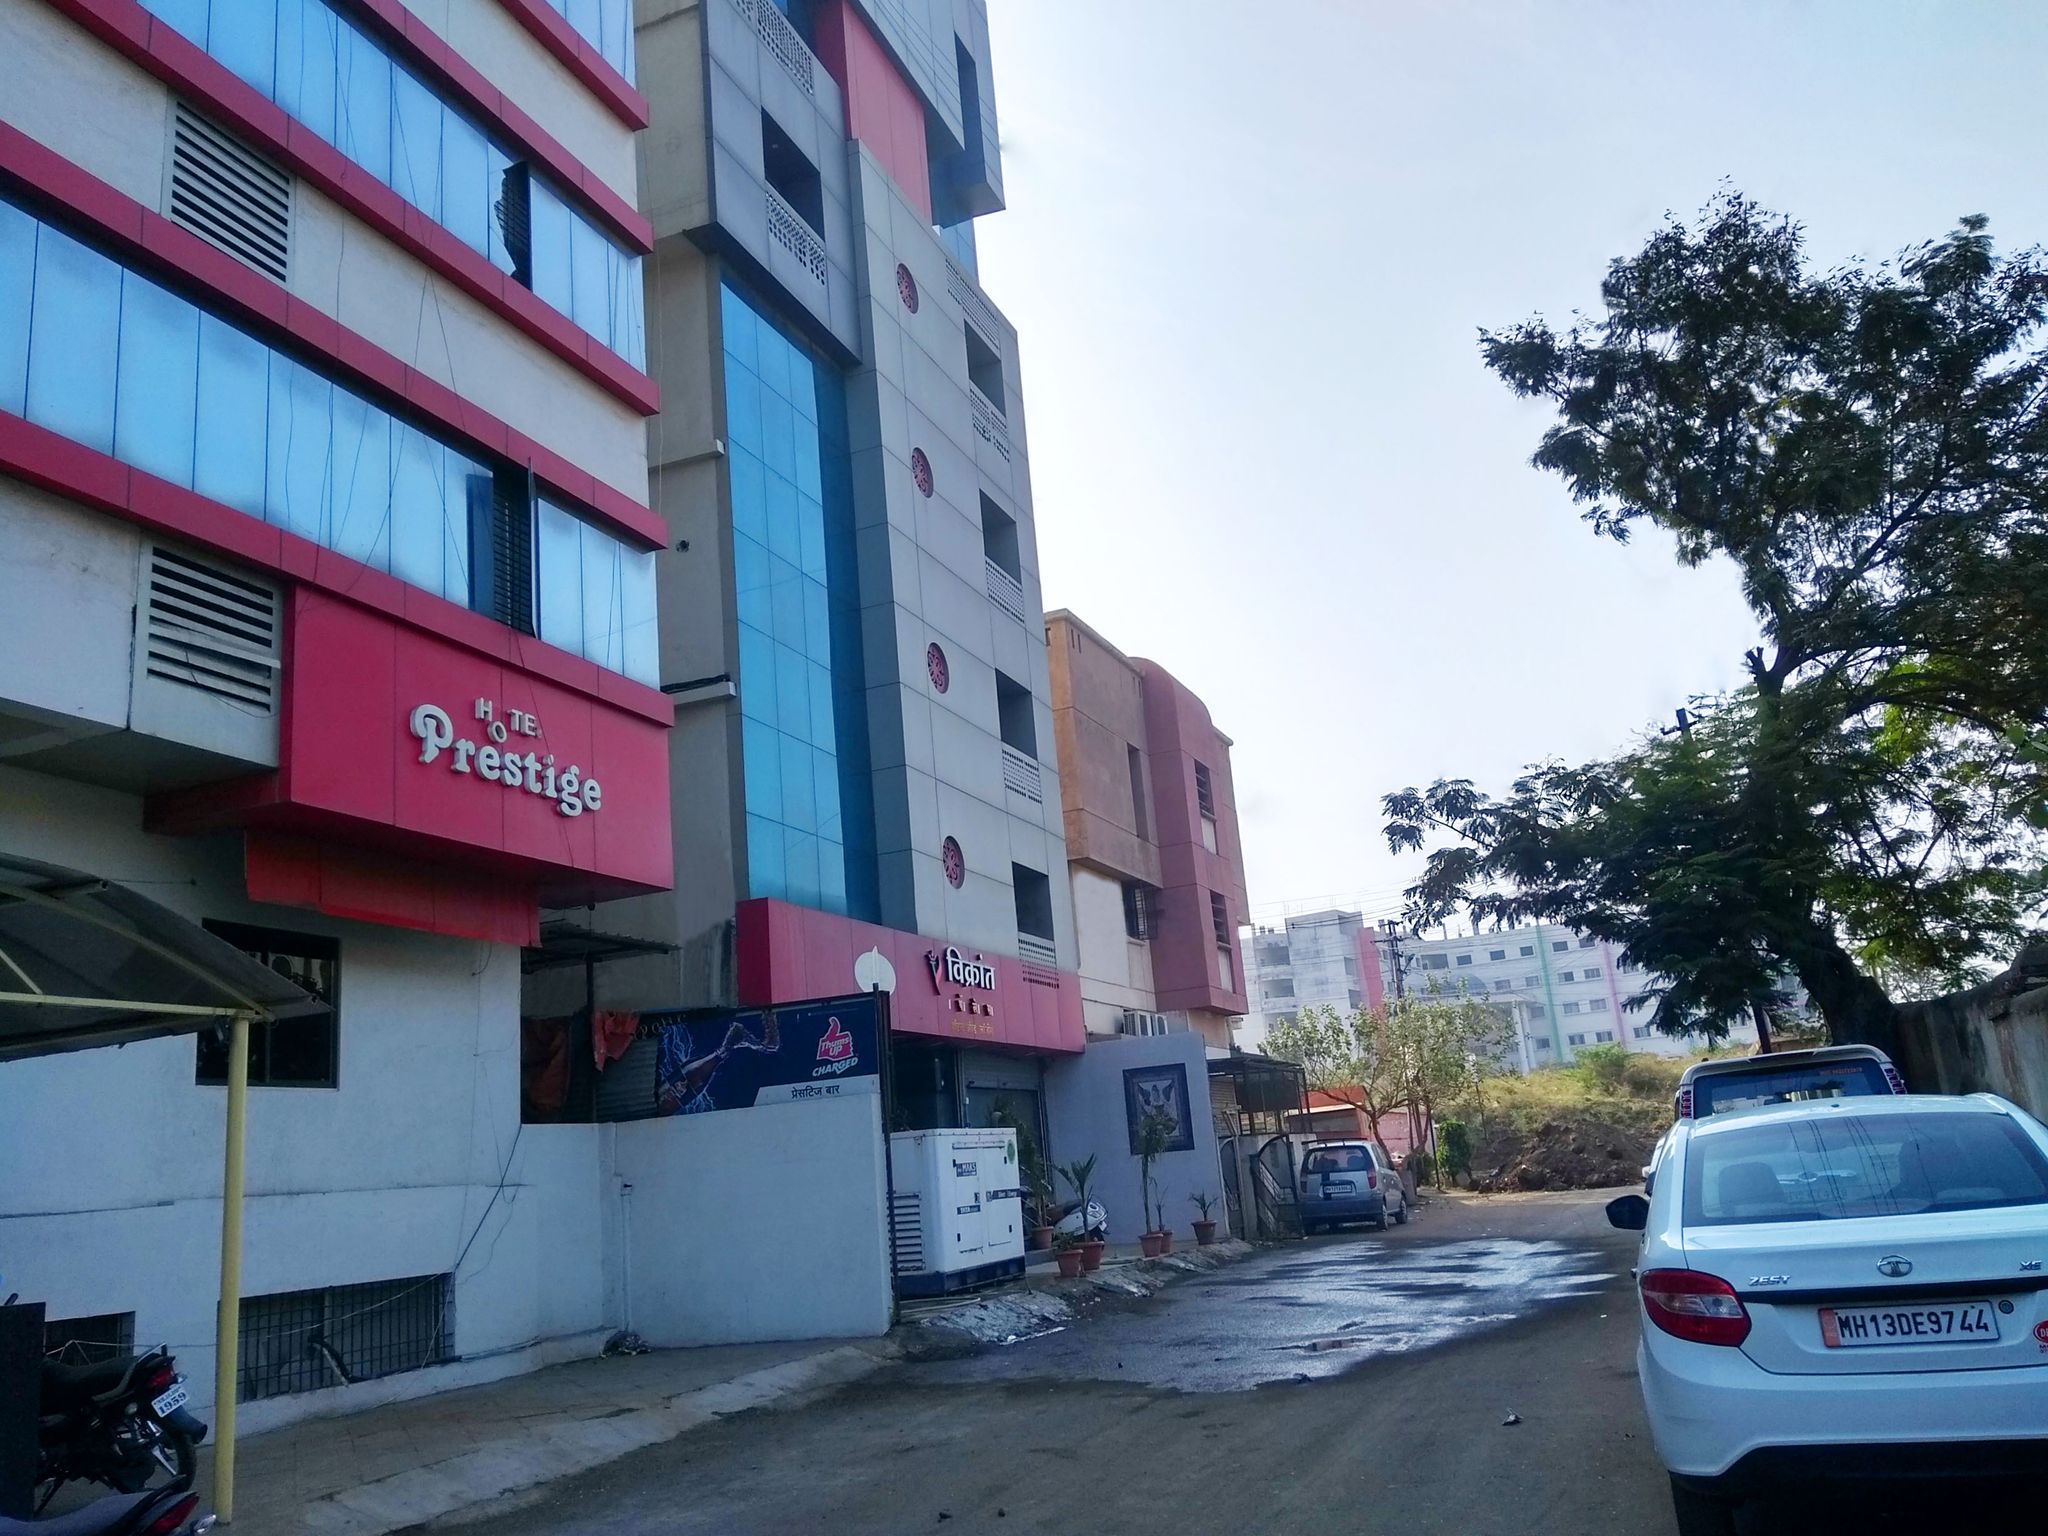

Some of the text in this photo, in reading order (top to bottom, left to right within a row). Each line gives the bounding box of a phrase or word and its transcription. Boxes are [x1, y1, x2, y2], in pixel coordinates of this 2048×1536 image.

[409, 703, 602, 817] Prestige
[945, 946, 996, 991] विक्रांत
[812, 1056, 859, 1077] CHARGED
[791, 1085, 840, 1099] प्रेसटिज बार
[2019, 1259, 2042, 1272] XE
[1748, 1274, 1790, 1287] ZEST
[1838, 1309, 1989, 1339] MH13DE9744
[159, 1392, 186, 1413] 1959
